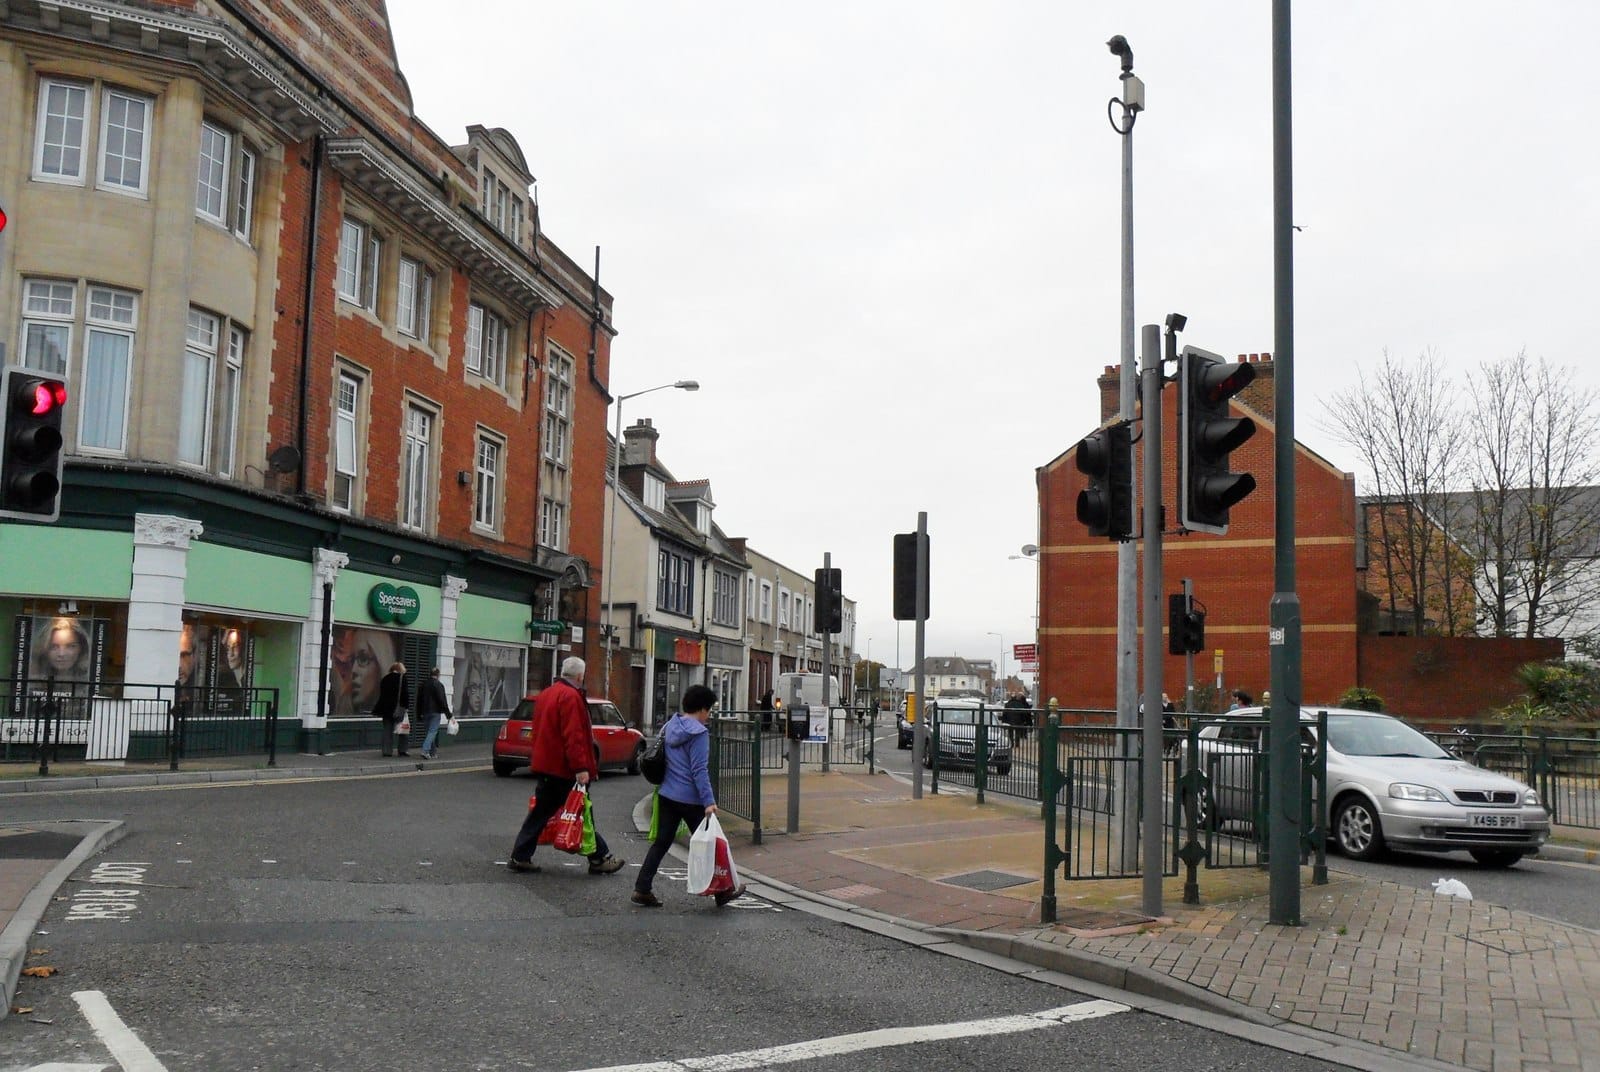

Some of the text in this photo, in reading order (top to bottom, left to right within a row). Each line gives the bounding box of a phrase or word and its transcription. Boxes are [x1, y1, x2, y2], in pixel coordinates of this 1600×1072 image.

[378, 591, 417, 608] Specsavers
[67, 728, 88, 737] ROA
[64, 889, 140, 923] RIGH
